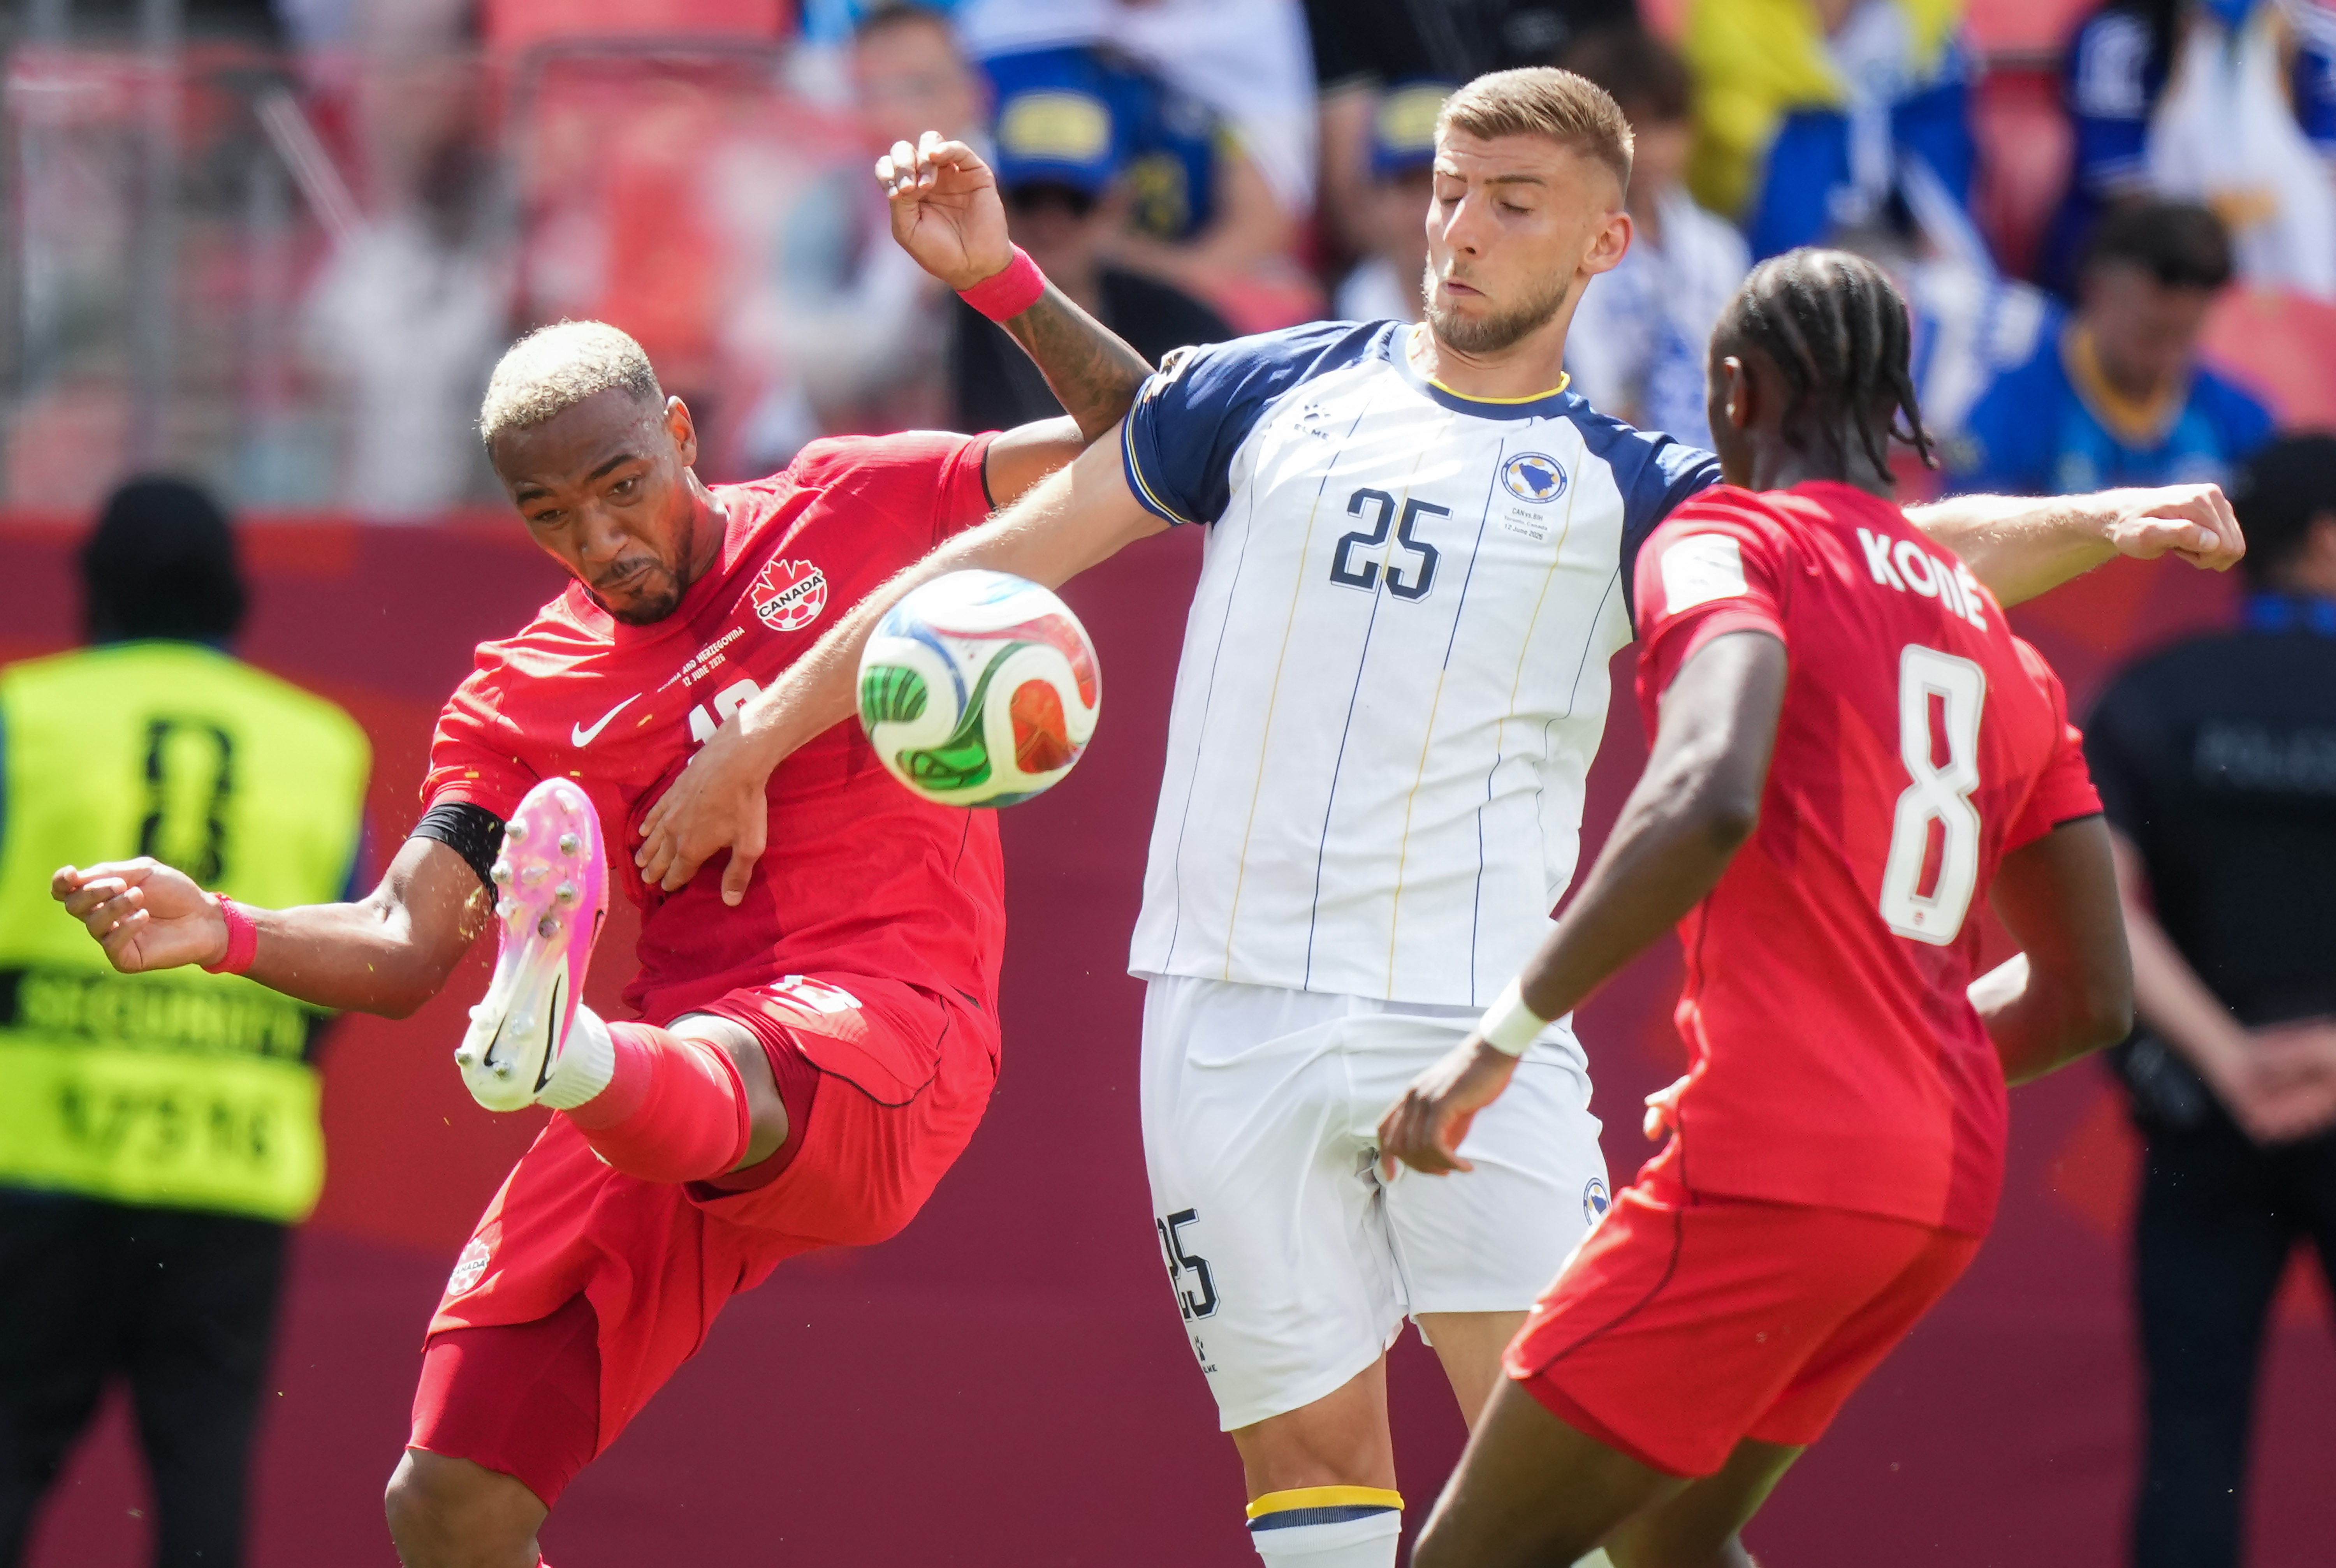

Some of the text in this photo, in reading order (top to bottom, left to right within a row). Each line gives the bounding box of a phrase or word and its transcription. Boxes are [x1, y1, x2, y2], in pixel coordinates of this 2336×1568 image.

[1330, 487, 1453, 604] 25
[759, 575, 823, 617] CANADA
[683, 659, 697, 675] AND
[696, 626, 746, 663] HERZEGOVINA
[683, 653, 726, 687] 12 JUNE 2026
[1880, 644, 1986, 946] 8
